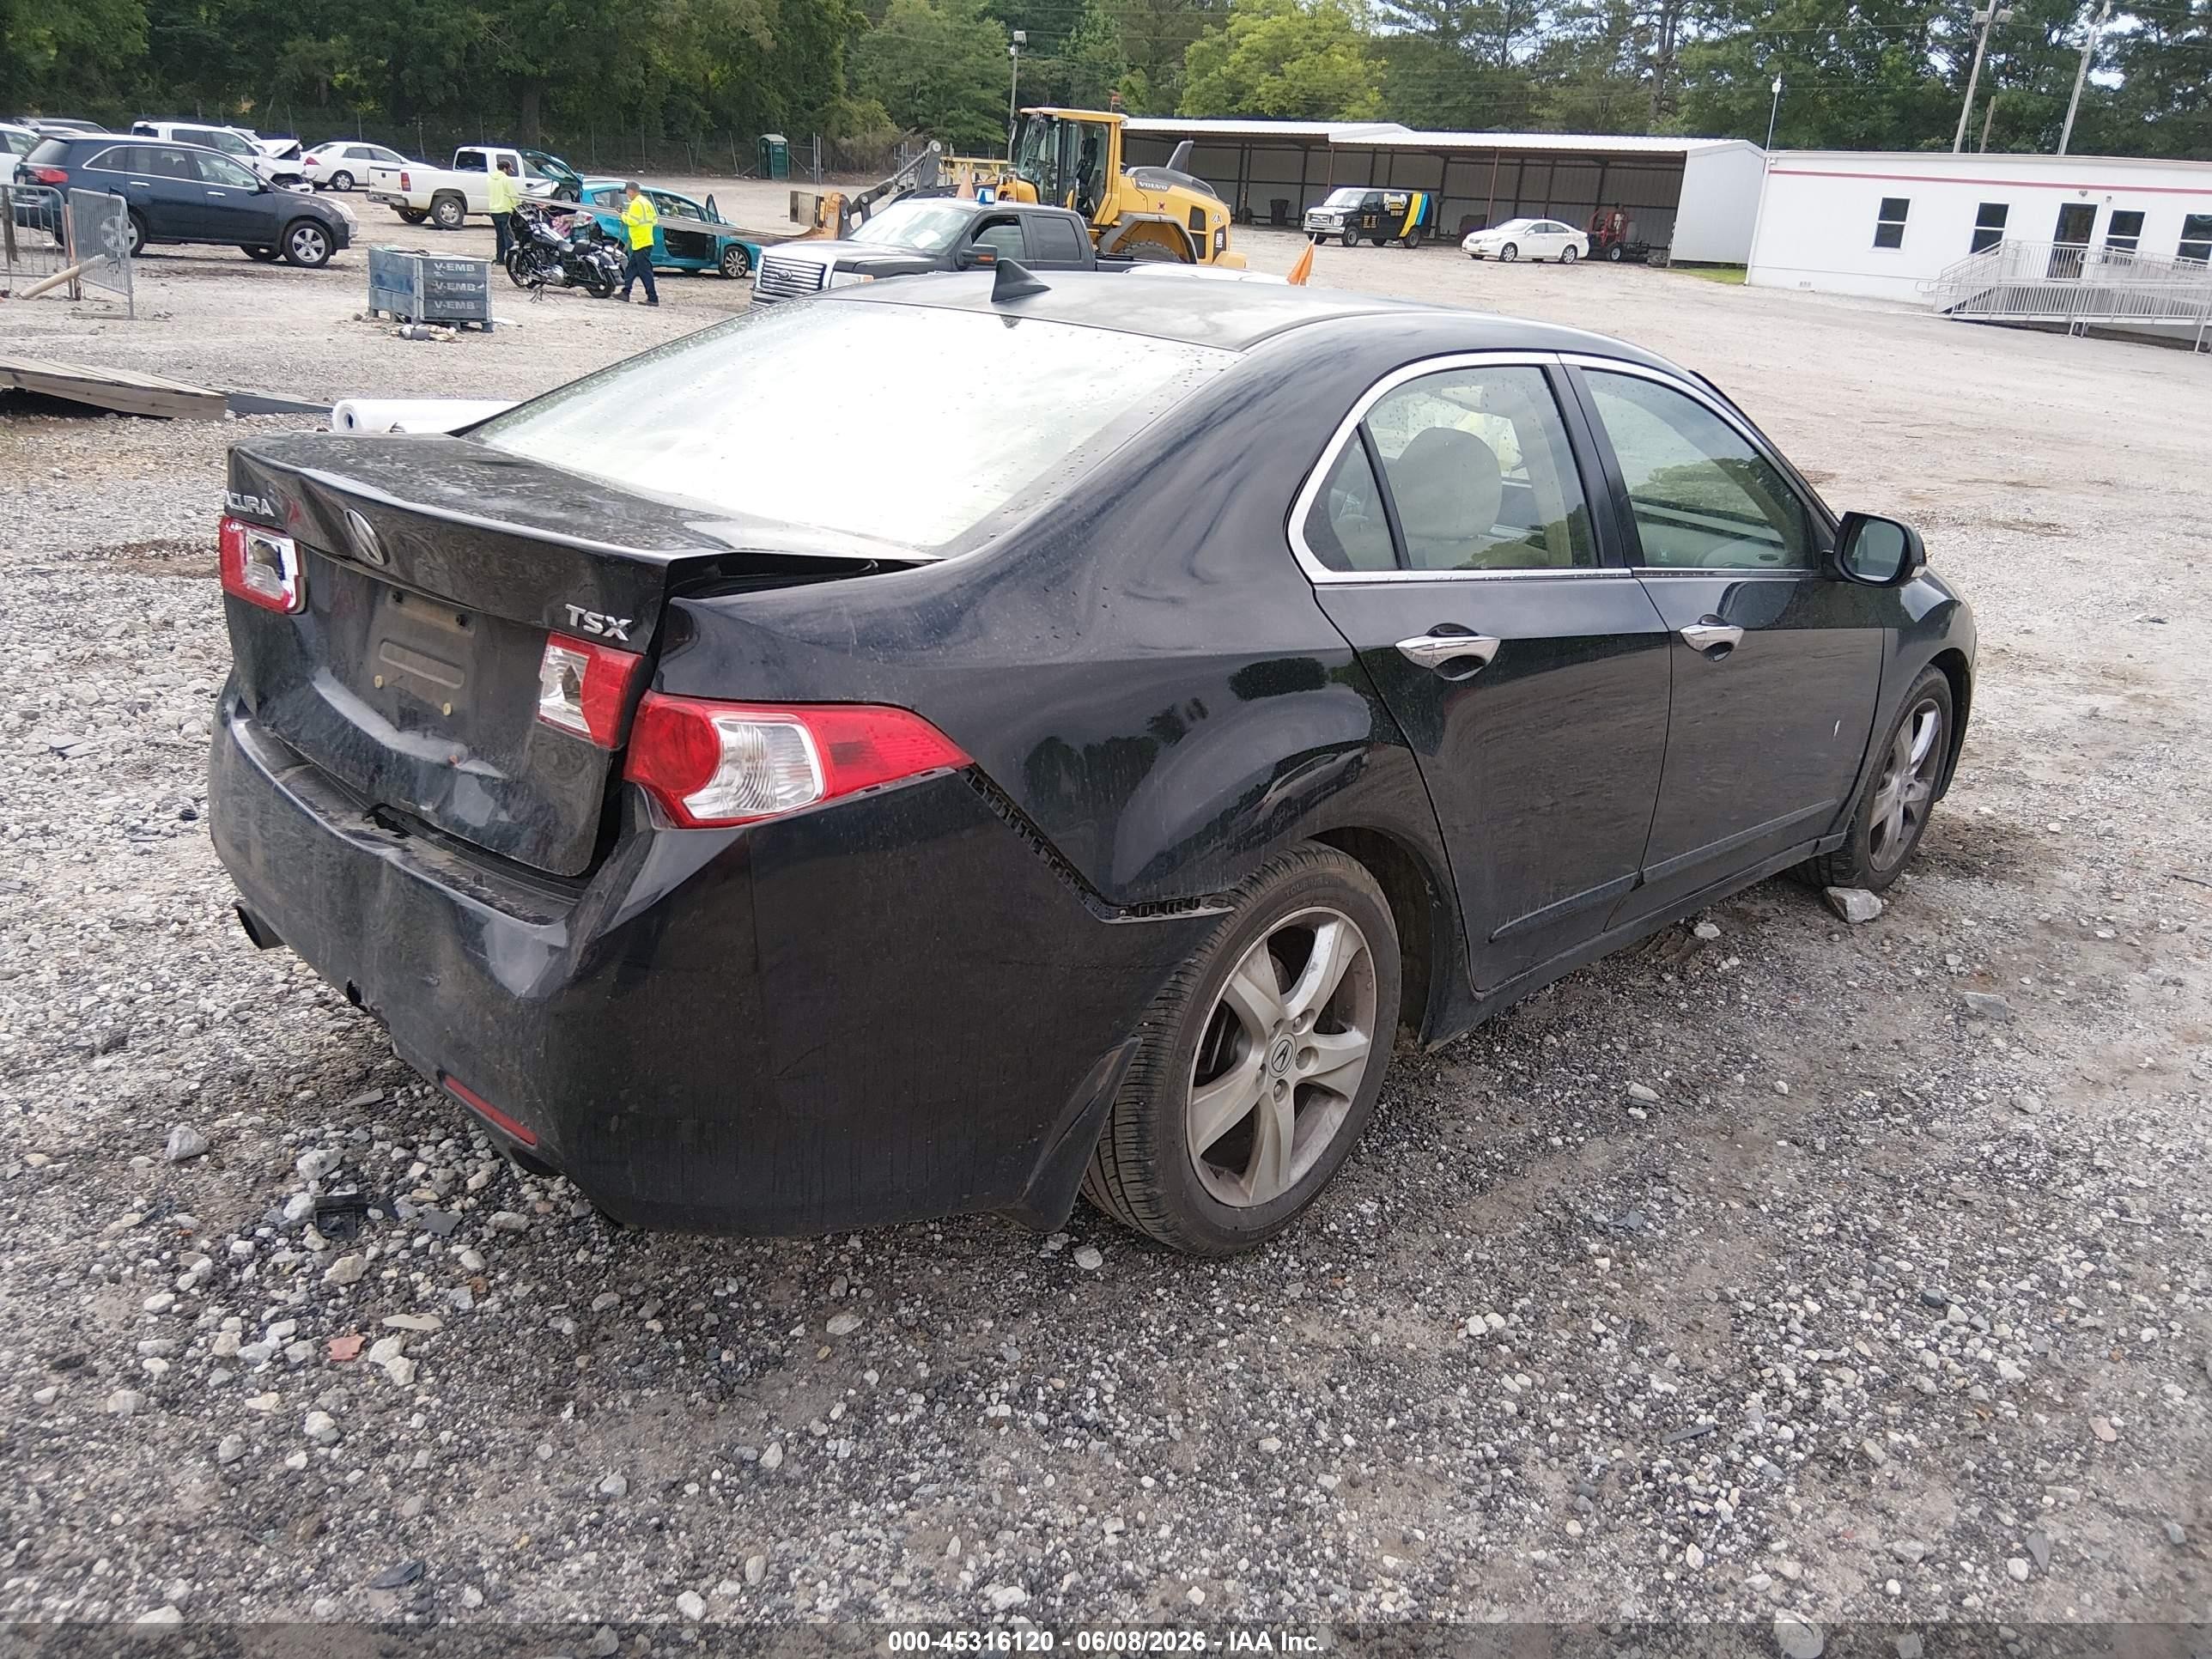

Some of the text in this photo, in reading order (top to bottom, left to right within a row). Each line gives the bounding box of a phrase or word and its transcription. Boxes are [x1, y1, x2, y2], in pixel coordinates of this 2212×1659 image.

[1139, 181, 1168, 191] VOLVO
[434, 263, 476, 272] V-EMB
[434, 282, 476, 292] V-EMB
[434, 301, 476, 310] V-EMB
[564, 603, 633, 641] TSX
